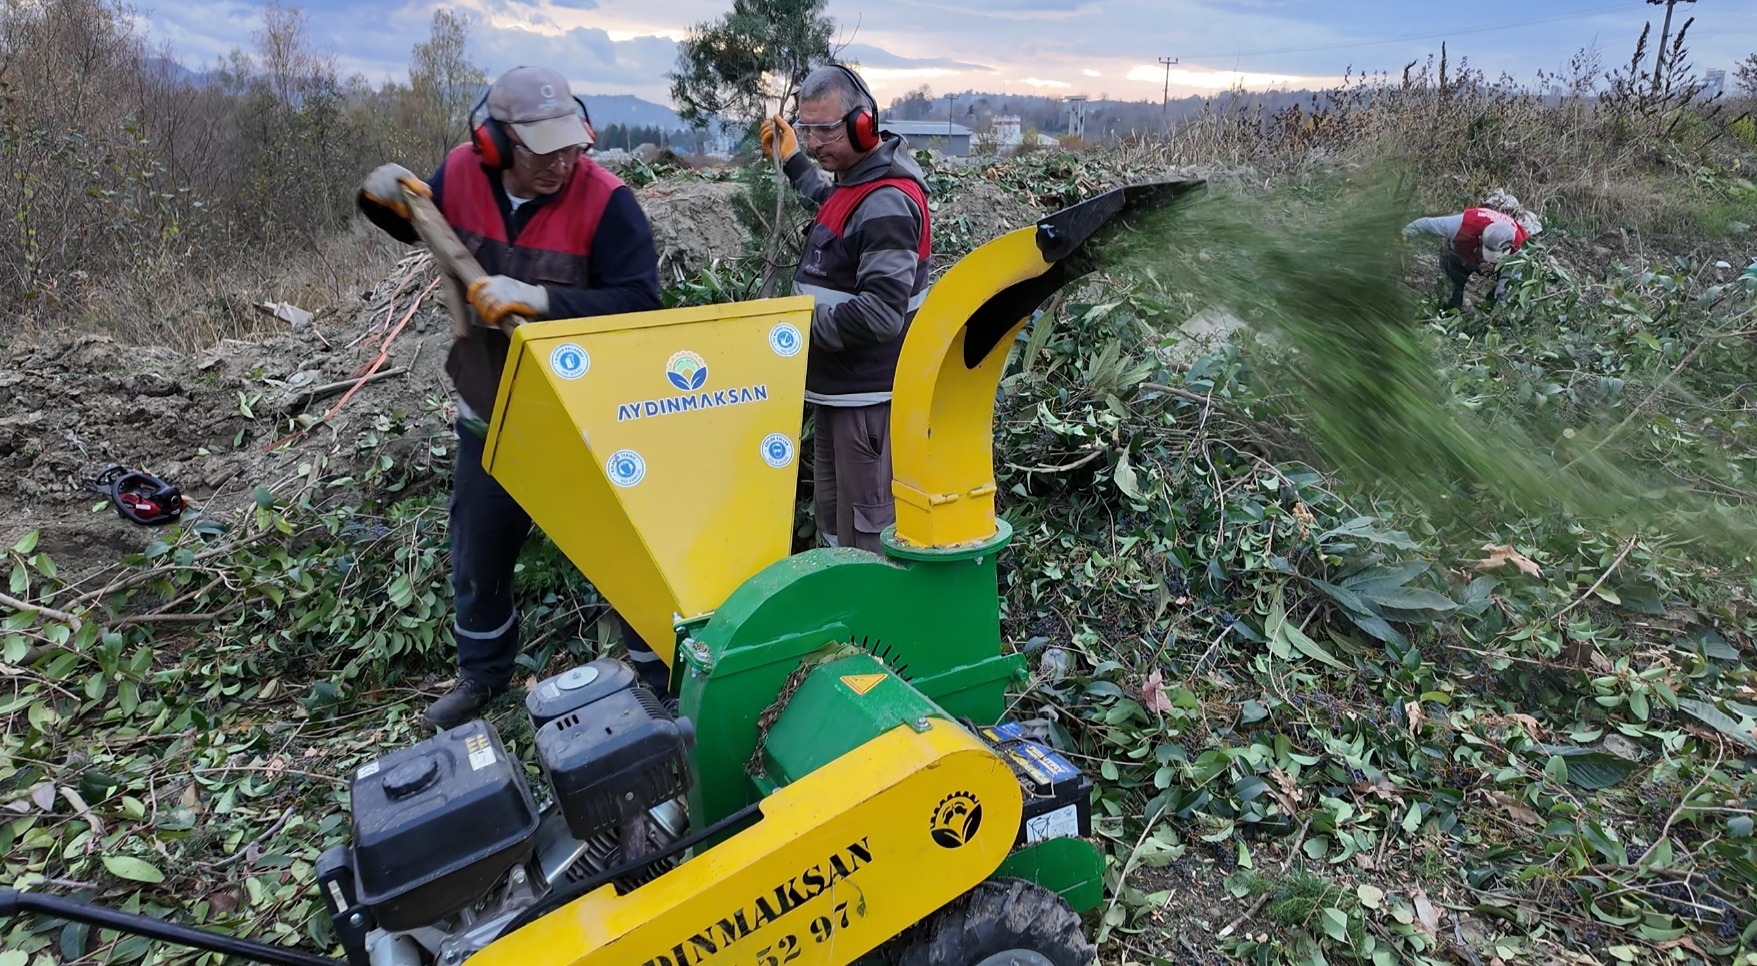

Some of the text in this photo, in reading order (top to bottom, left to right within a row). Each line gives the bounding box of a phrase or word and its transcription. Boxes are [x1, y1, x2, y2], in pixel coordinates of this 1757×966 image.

[618, 385, 768, 421] AYDINMAKSAN
[756, 900, 850, 966] 52 97
